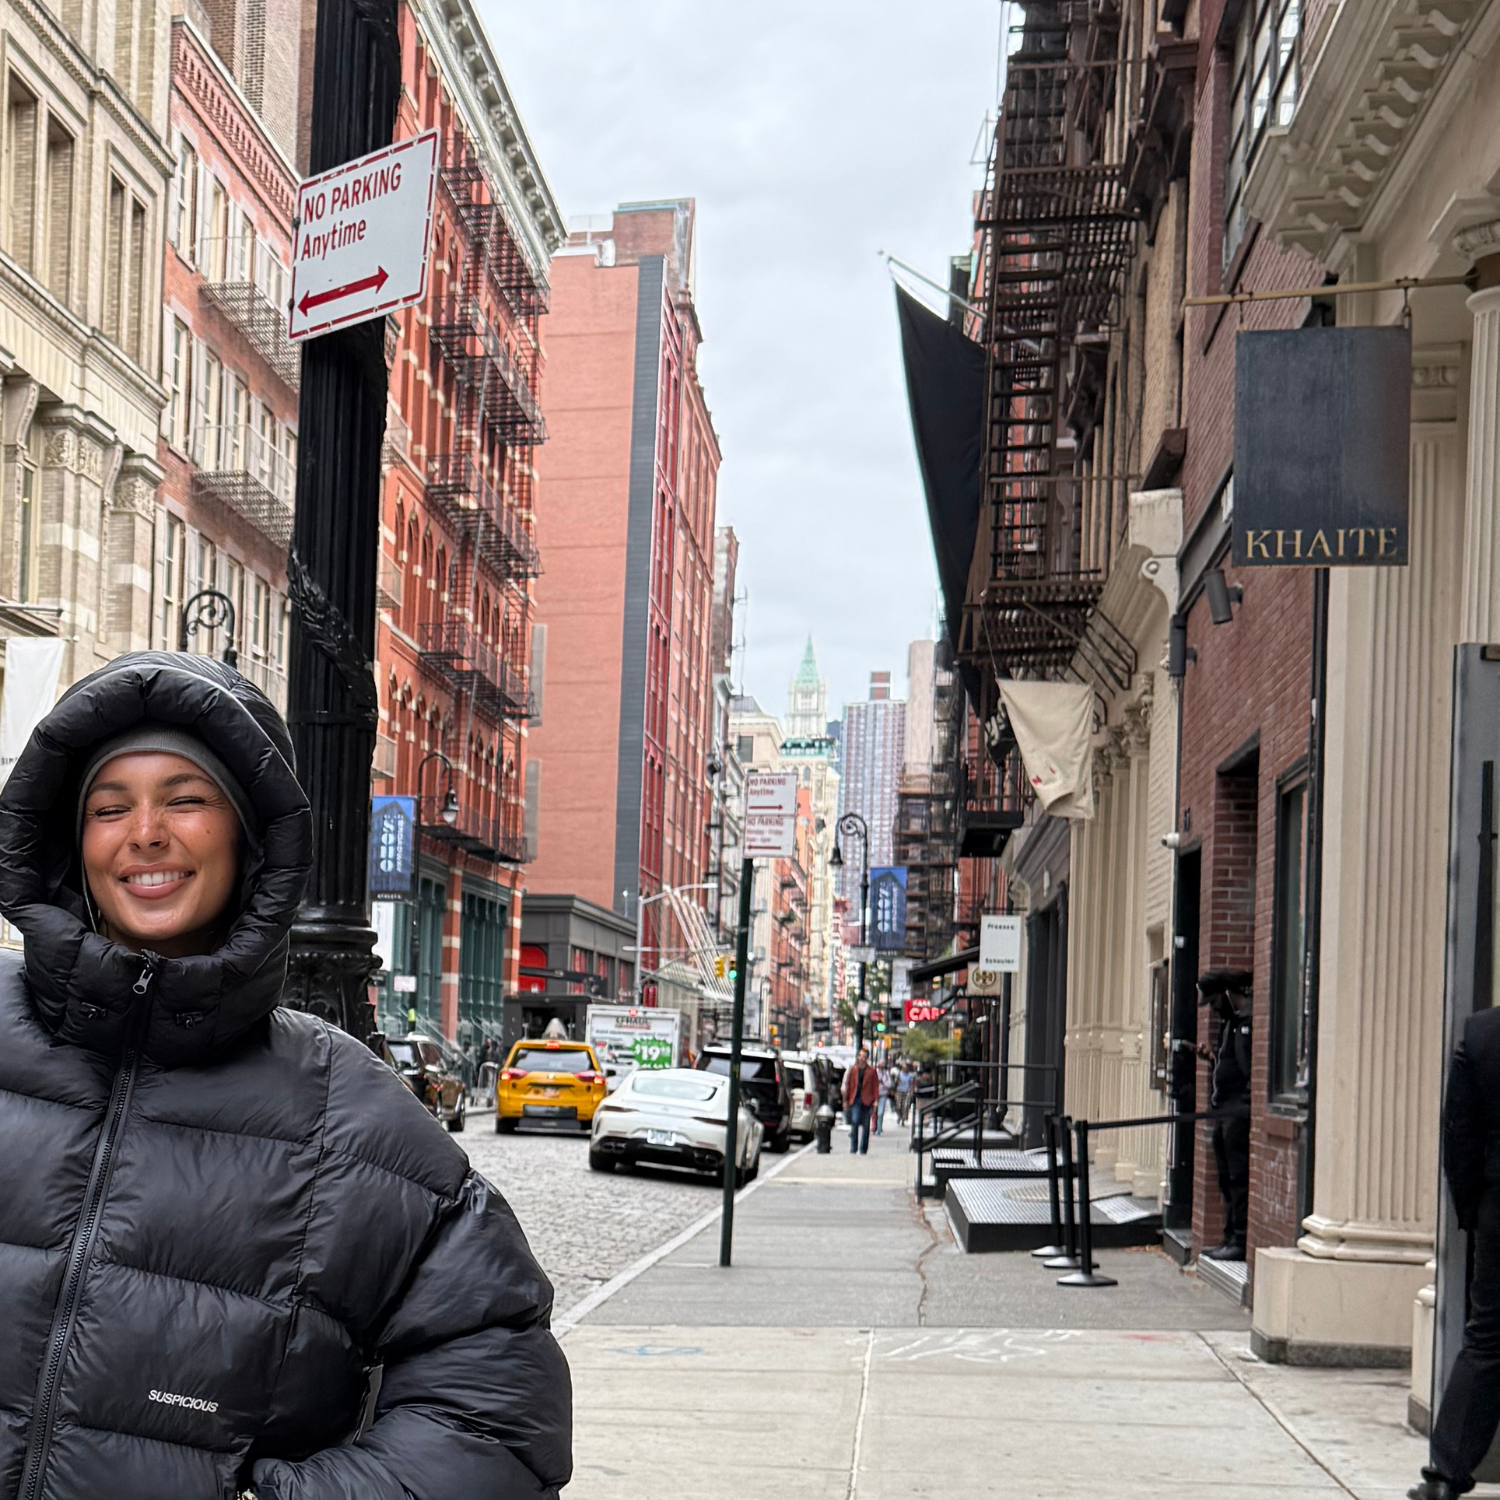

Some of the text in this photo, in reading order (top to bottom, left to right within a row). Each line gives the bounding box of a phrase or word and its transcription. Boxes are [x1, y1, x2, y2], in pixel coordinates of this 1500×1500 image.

[303, 161, 402, 226] NO PARKING
[300, 218, 367, 262] Anytime
[1245, 528, 1397, 559] KHAITE
[749, 777, 786, 786] NO PARKING
[148, 1389, 219, 1413] SUSPICIOUS
